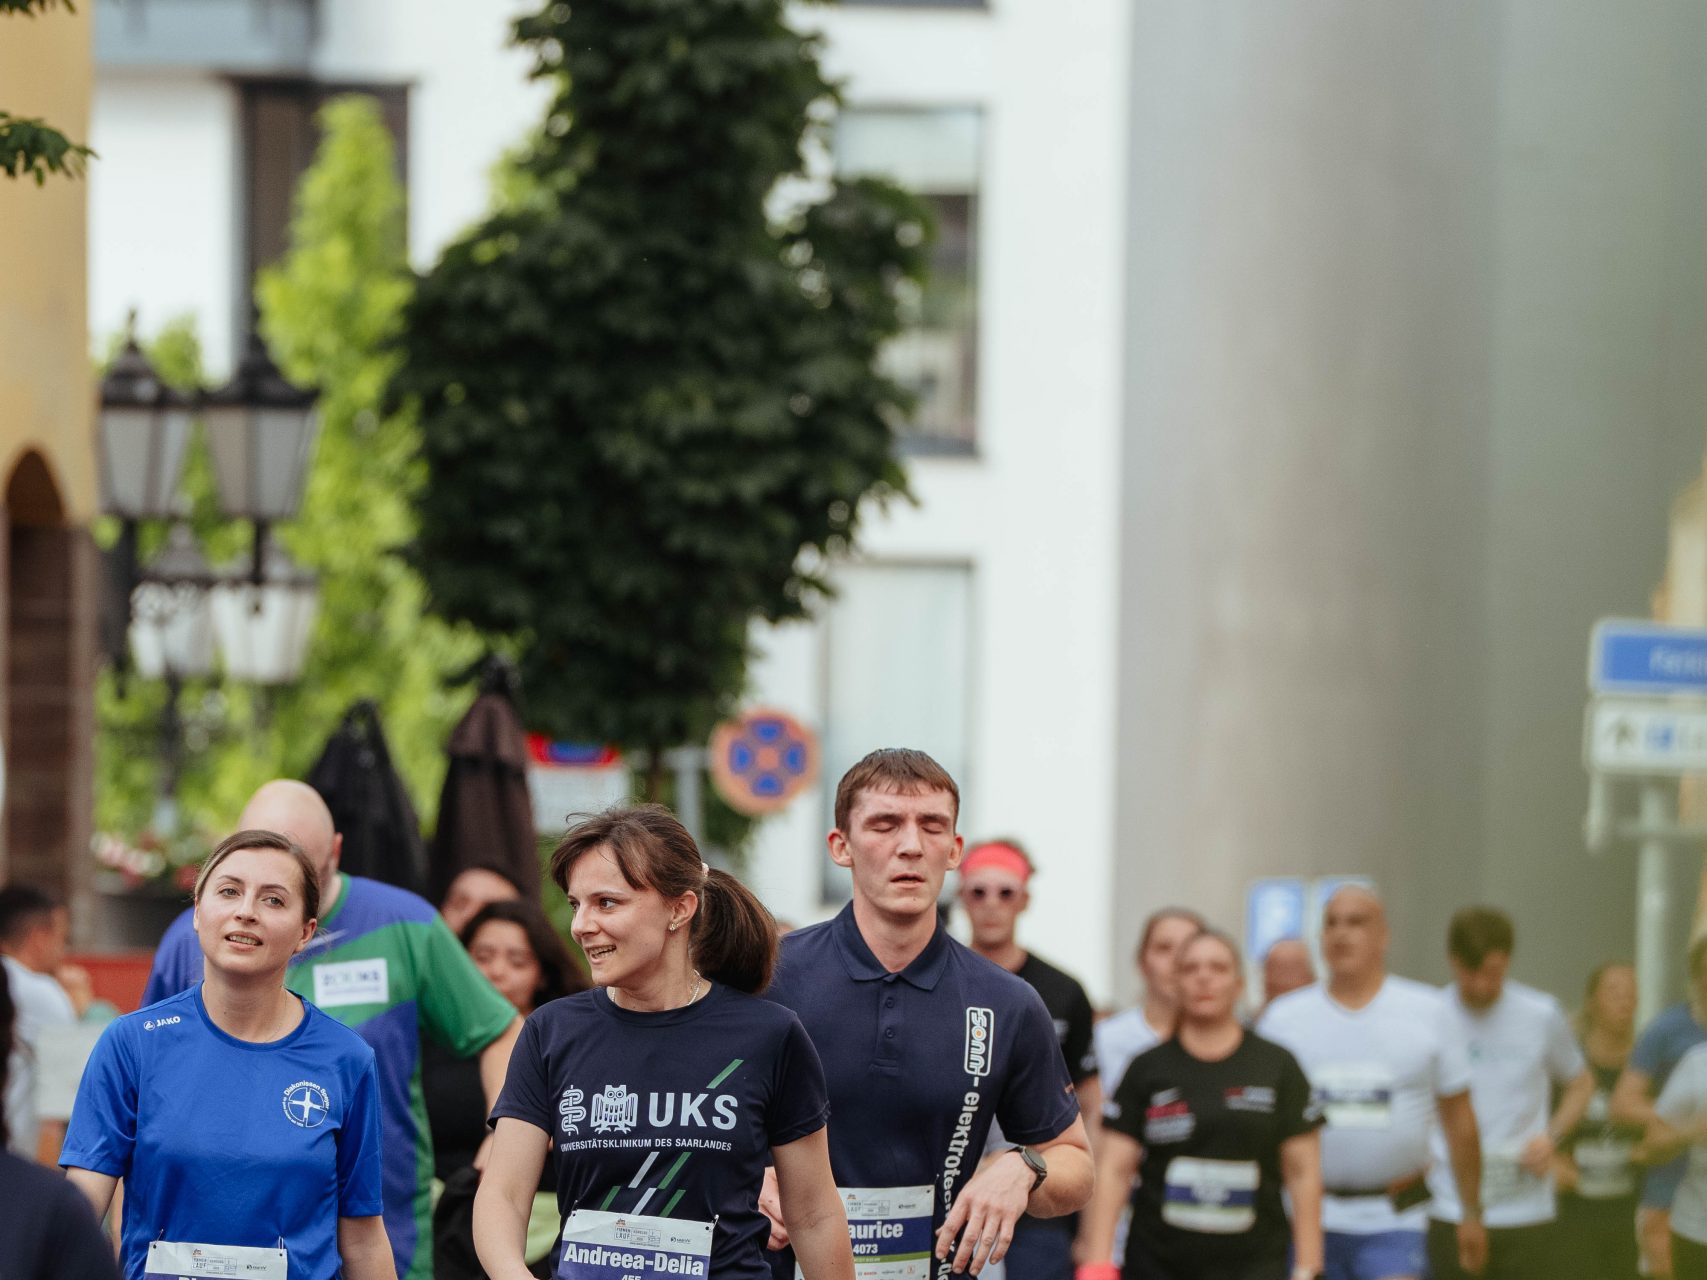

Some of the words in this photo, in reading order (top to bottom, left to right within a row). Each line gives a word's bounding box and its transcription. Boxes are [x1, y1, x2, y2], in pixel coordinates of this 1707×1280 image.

[156, 1015, 181, 1027] JAKO
[283, 1080, 321, 1096] Diakonissen
[648, 1092, 738, 1130] UKS
[560, 1137, 652, 1152] UNIVERSITÄTSKLINIKUM
[654, 1138, 672, 1148] DES
[675, 1138, 732, 1151] SAARLANDES
[848, 1221, 904, 1239] aurice
[853, 1243, 878, 1255] 4073
[563, 1243, 704, 1276] Andreea-Delia
